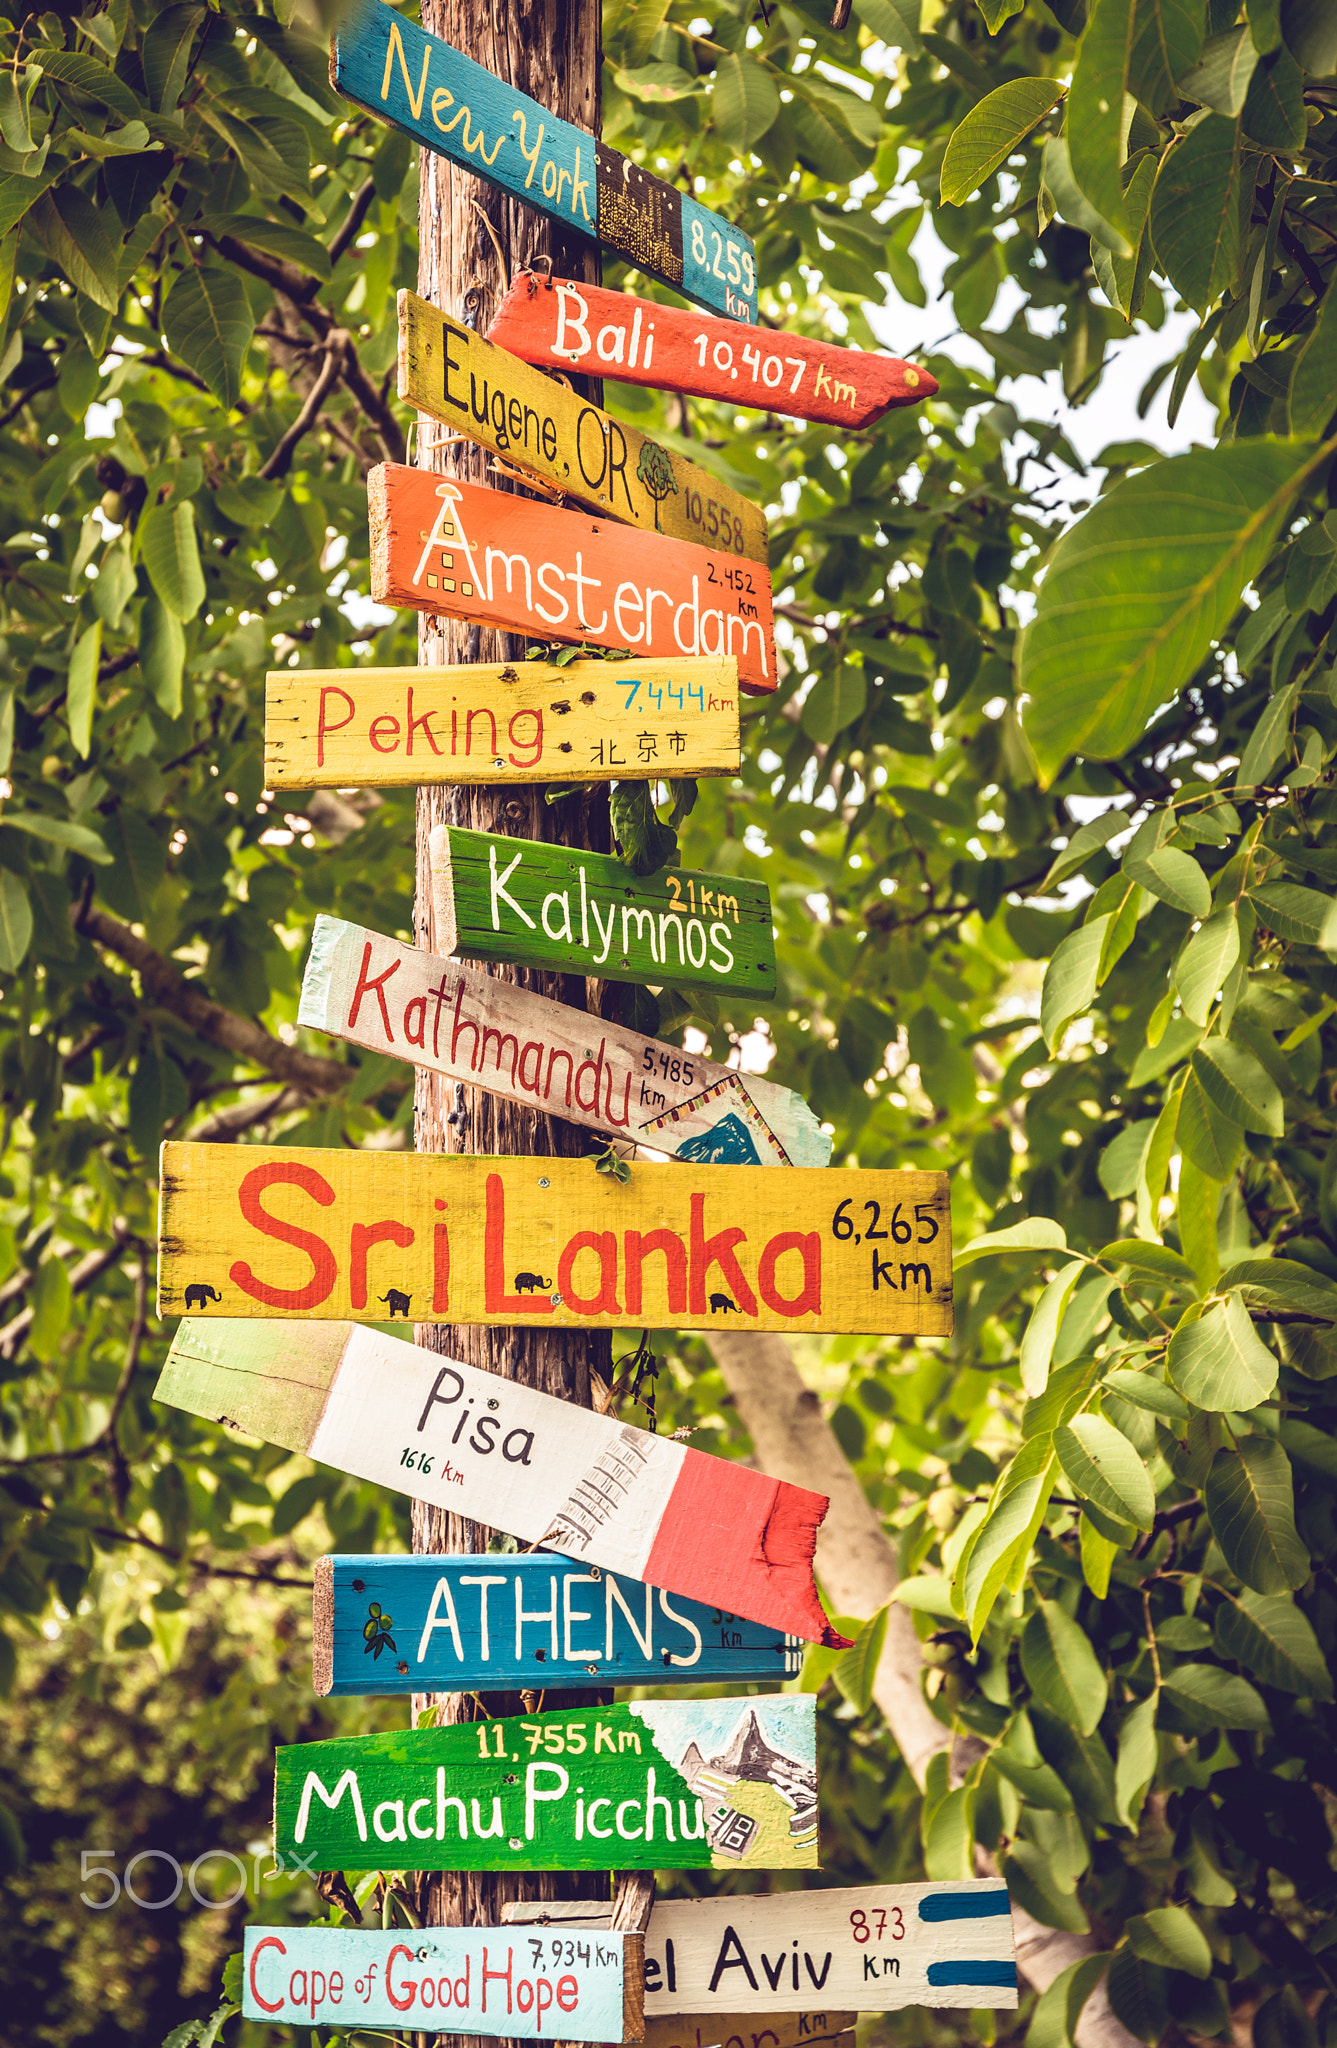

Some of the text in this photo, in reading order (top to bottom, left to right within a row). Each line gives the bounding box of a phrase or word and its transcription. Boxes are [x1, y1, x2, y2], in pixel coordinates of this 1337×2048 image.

[381, 22, 591, 221] New York
[725, 284, 751, 324] km
[551, 285, 857, 409] Bali 10,407 km
[685, 486, 745, 554] 10,558
[413, 494, 769, 678] Amsterdam
[707, 562, 757, 595] 2,452
[738, 597, 758, 619] km
[317, 686, 544, 768] Peking
[590, 731, 688, 765] 北京市
[488, 845, 735, 974] Kalymnos
[348, 941, 632, 1127] Kathmandu
[642, 1047, 694, 1086] 5,485
[640, 1080, 665, 1110] km
[229, 1162, 822, 1318] Sri Lanka
[832, 1198, 939, 1245] 6,265
[872, 1248, 933, 1294] km
[417, 1366, 535, 1467] Pisa
[400, 1447, 465, 1486] 1616 km
[417, 1573, 703, 1667] ATHENS
[476, 1722, 587, 1762] 11,755
[294, 1761, 705, 1843] Machu Picchu
[528, 1938, 590, 1972] 7,934
[644, 1925, 832, 1992] el Aviv
[850, 1907, 906, 1943] 873
[249, 1936, 579, 2032] Cape of Good Hope
